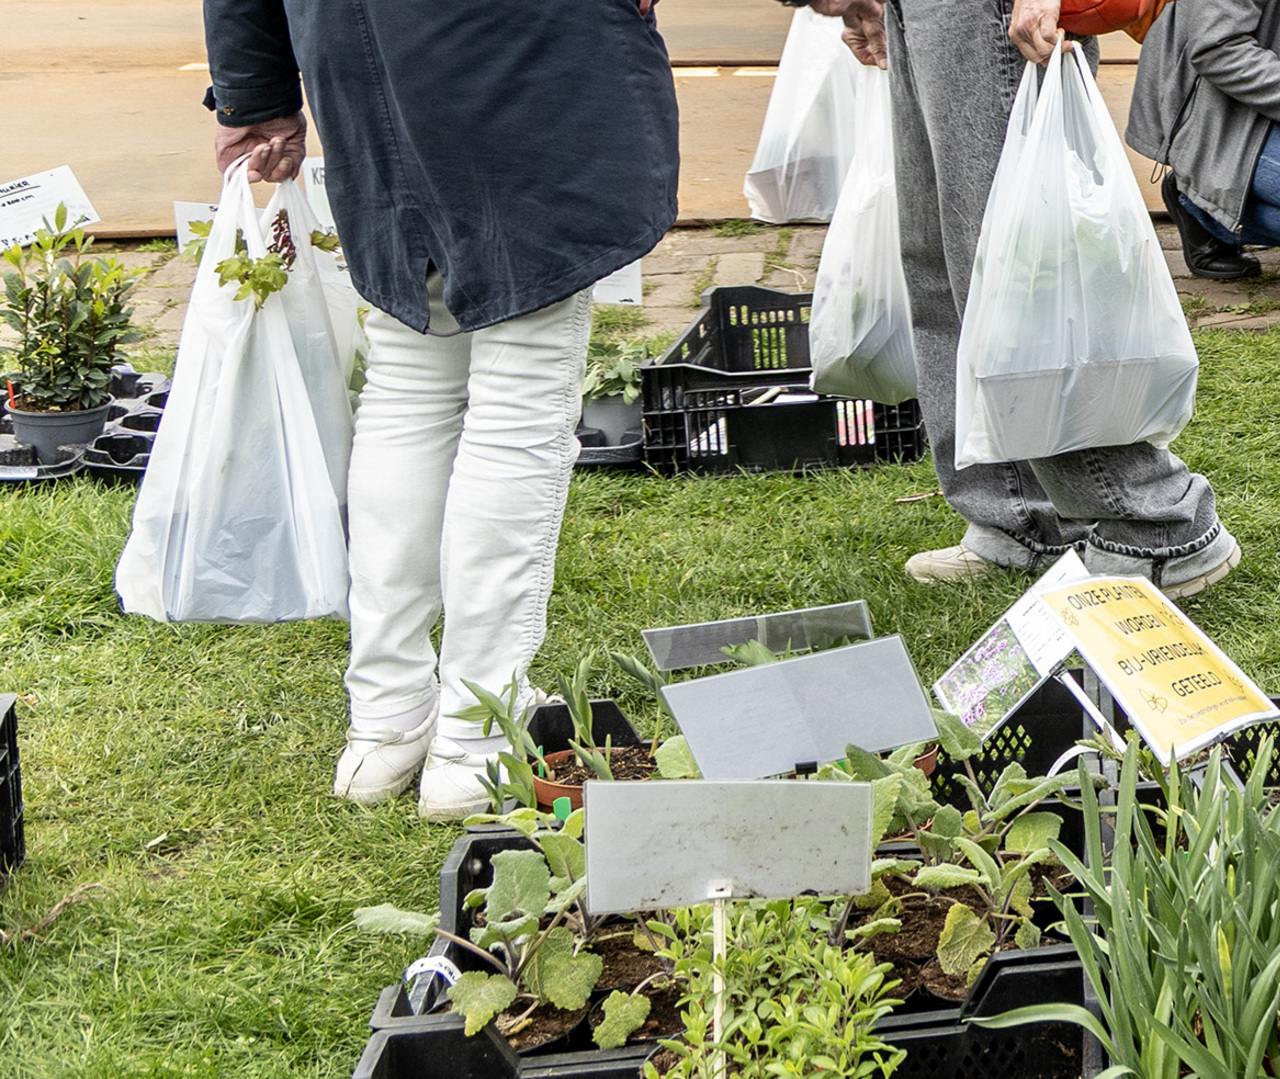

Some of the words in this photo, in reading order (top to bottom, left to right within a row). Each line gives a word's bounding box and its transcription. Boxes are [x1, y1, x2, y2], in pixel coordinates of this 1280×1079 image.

[1067, 590, 1107, 610] ONZE
[1114, 614, 1167, 635] WORDEN
[1117, 642, 1208, 676] BIJ-VRIENDELIJK
[1171, 671, 1222, 697] GETEELD
